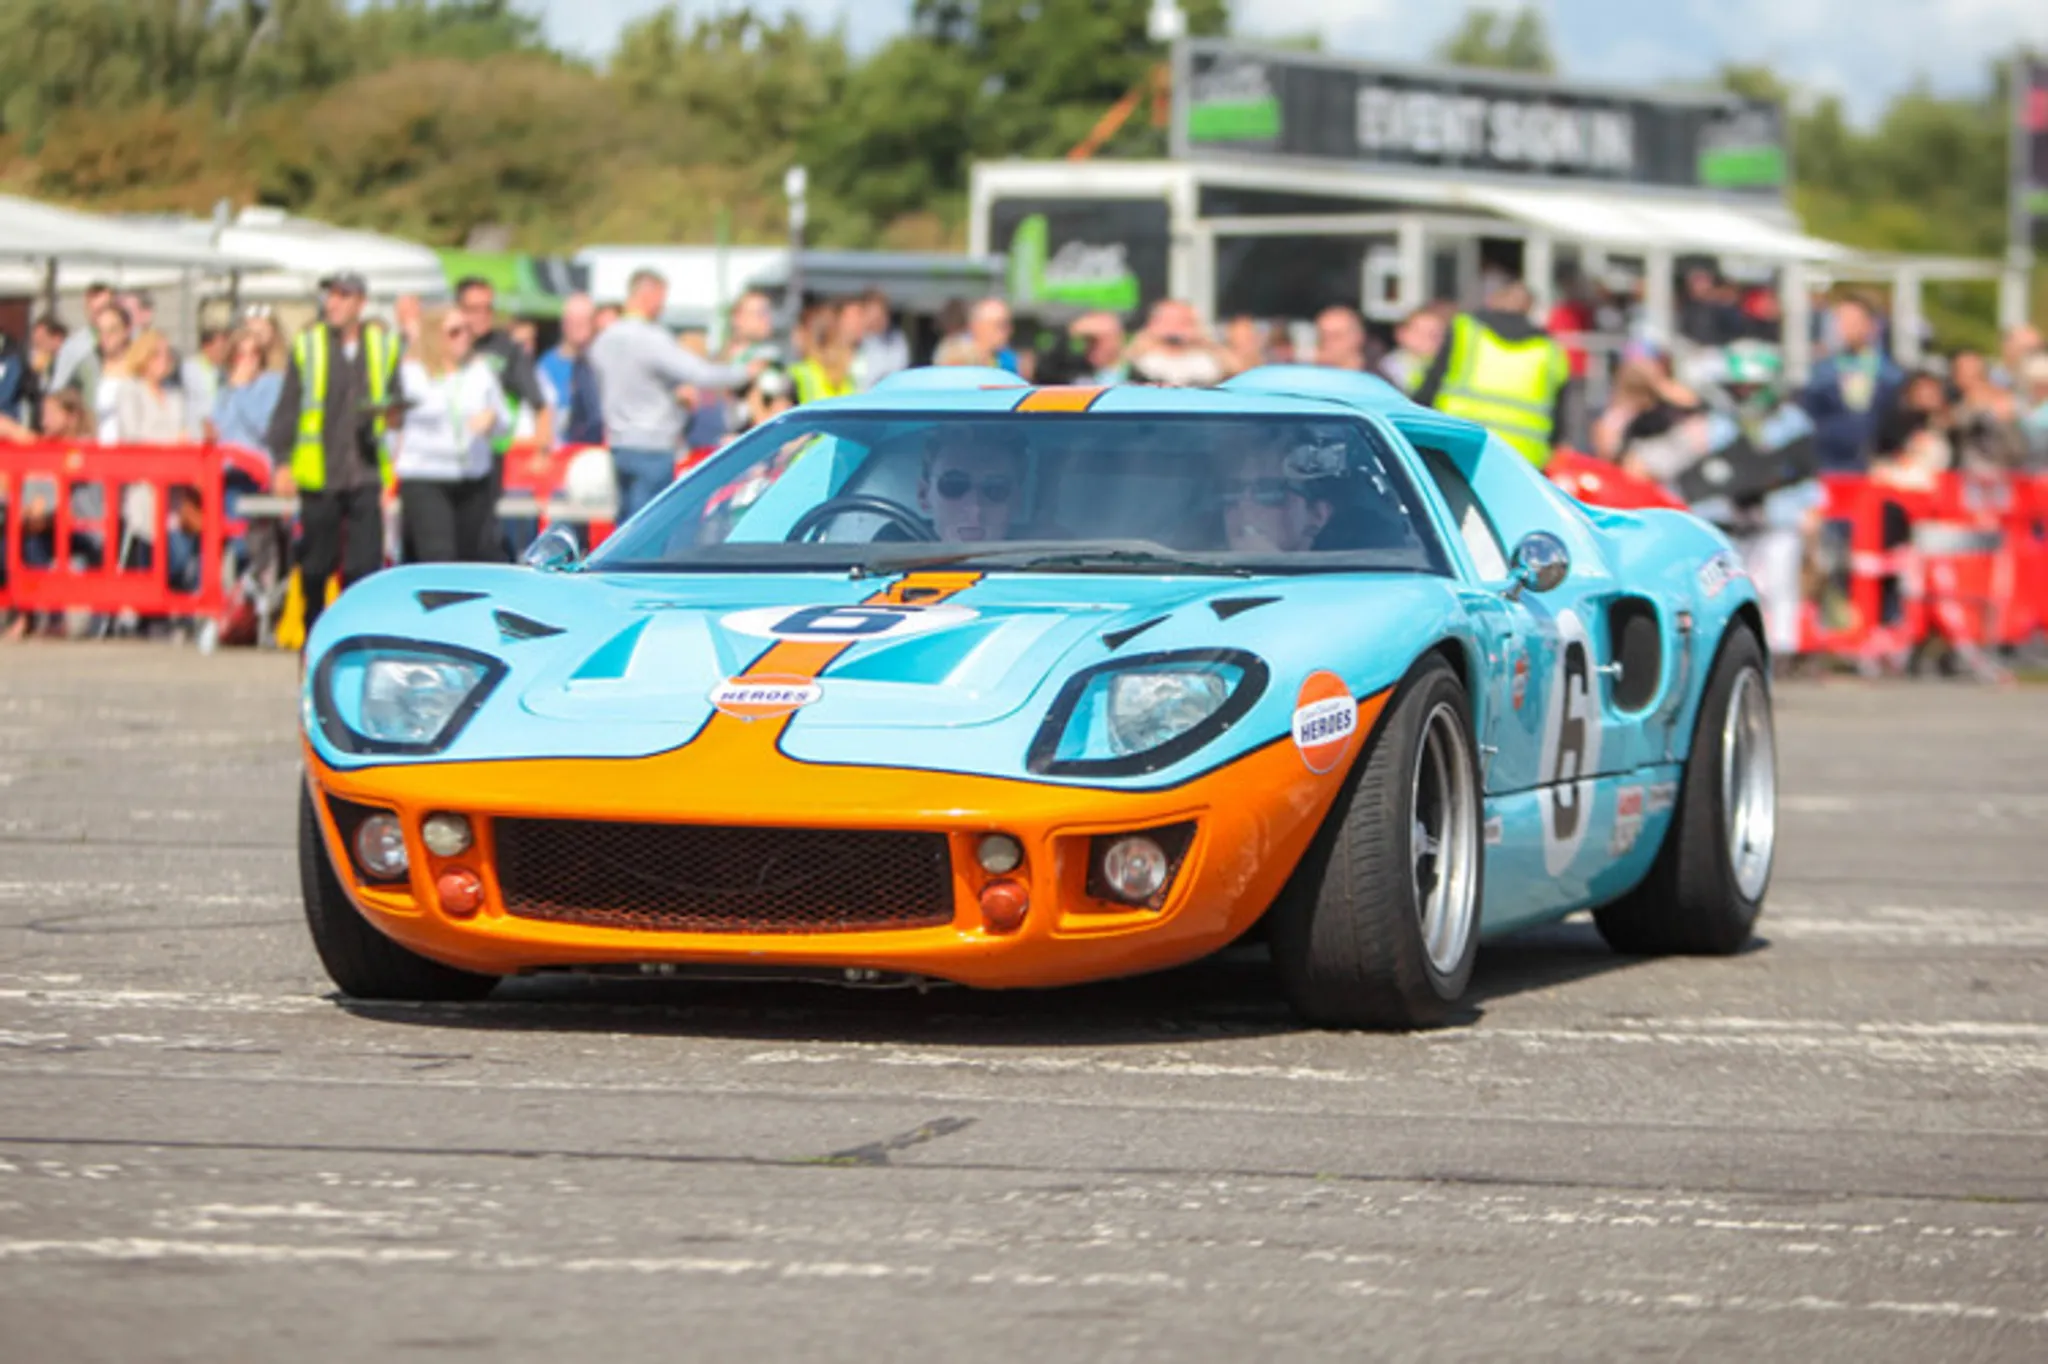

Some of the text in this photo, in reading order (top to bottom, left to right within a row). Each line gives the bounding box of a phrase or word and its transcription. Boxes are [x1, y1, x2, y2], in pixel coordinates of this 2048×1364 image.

[1356, 87, 1487, 157] EVENT
[770, 605, 926, 634] 6
[720, 690, 809, 701] HEROES
[1300, 709, 1351, 744] HEROES
[1553, 640, 1589, 841] 6
